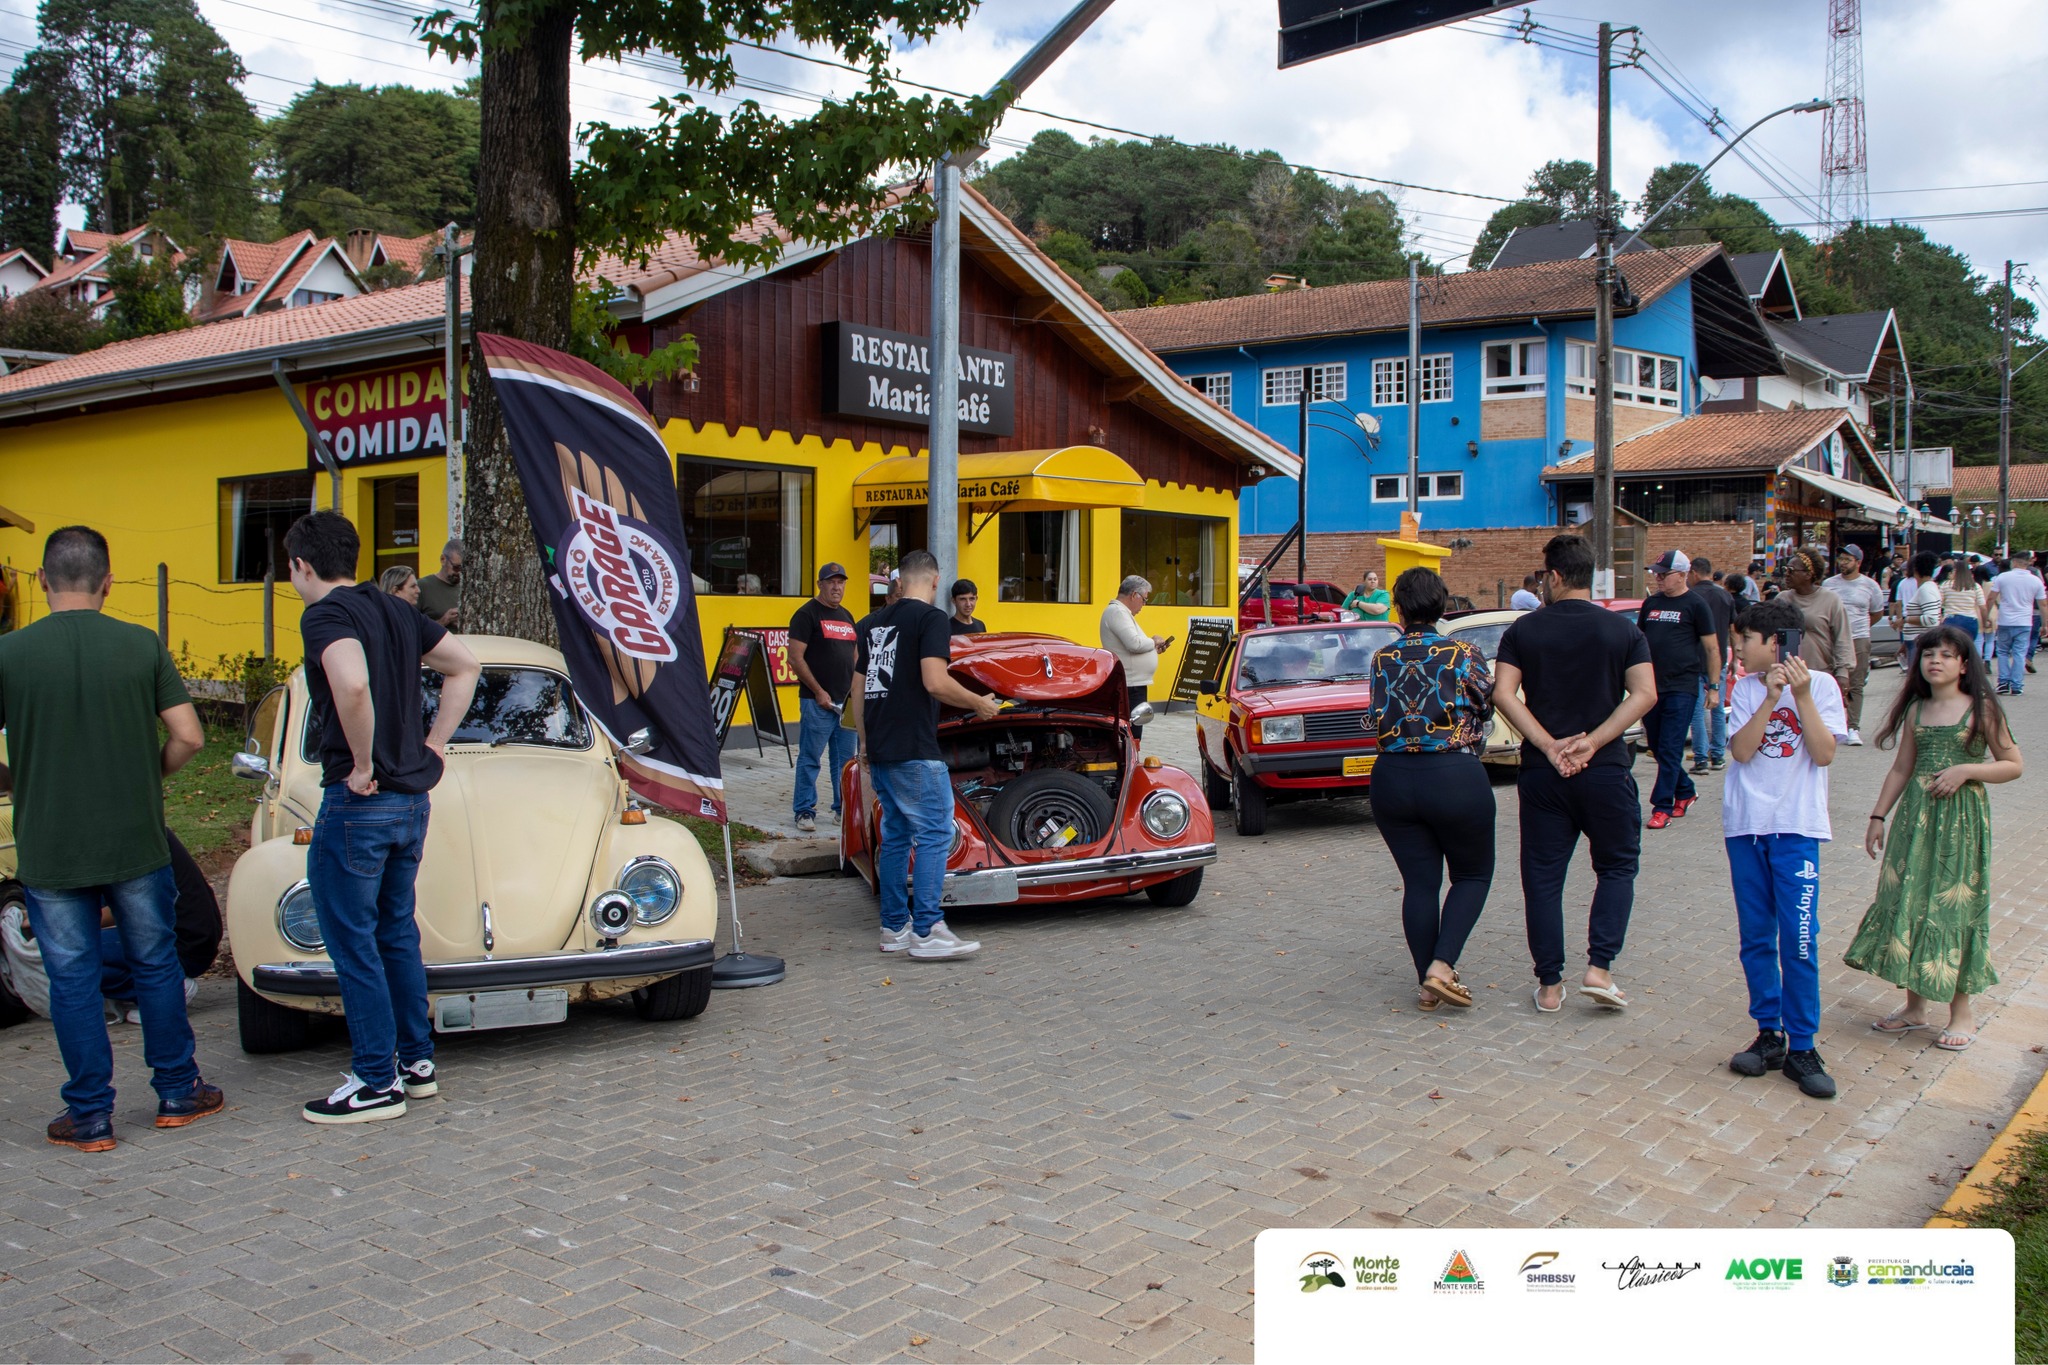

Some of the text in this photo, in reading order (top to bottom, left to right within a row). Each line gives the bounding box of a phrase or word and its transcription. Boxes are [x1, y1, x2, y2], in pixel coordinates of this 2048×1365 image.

[851, 333, 1005, 388] RESTAUANTE
[314, 366, 446, 420] COMIDA
[958, 392, 990, 424] afé
[314, 412, 447, 464] COMIDA
[866, 480, 1020, 502] RESTAURAN aria Café
[570, 549, 606, 619] RETRÔ
[578, 494, 670, 656] GARAGE
[628, 534, 673, 616] EXTREMA-MG
[642, 568, 653, 591] 2018
[768, 631, 789, 646] CASE
[1659, 610, 1681, 620] DIESEL
[867, 670, 877, 690] COAST
[1796, 884, 1814, 960] PlayStation
